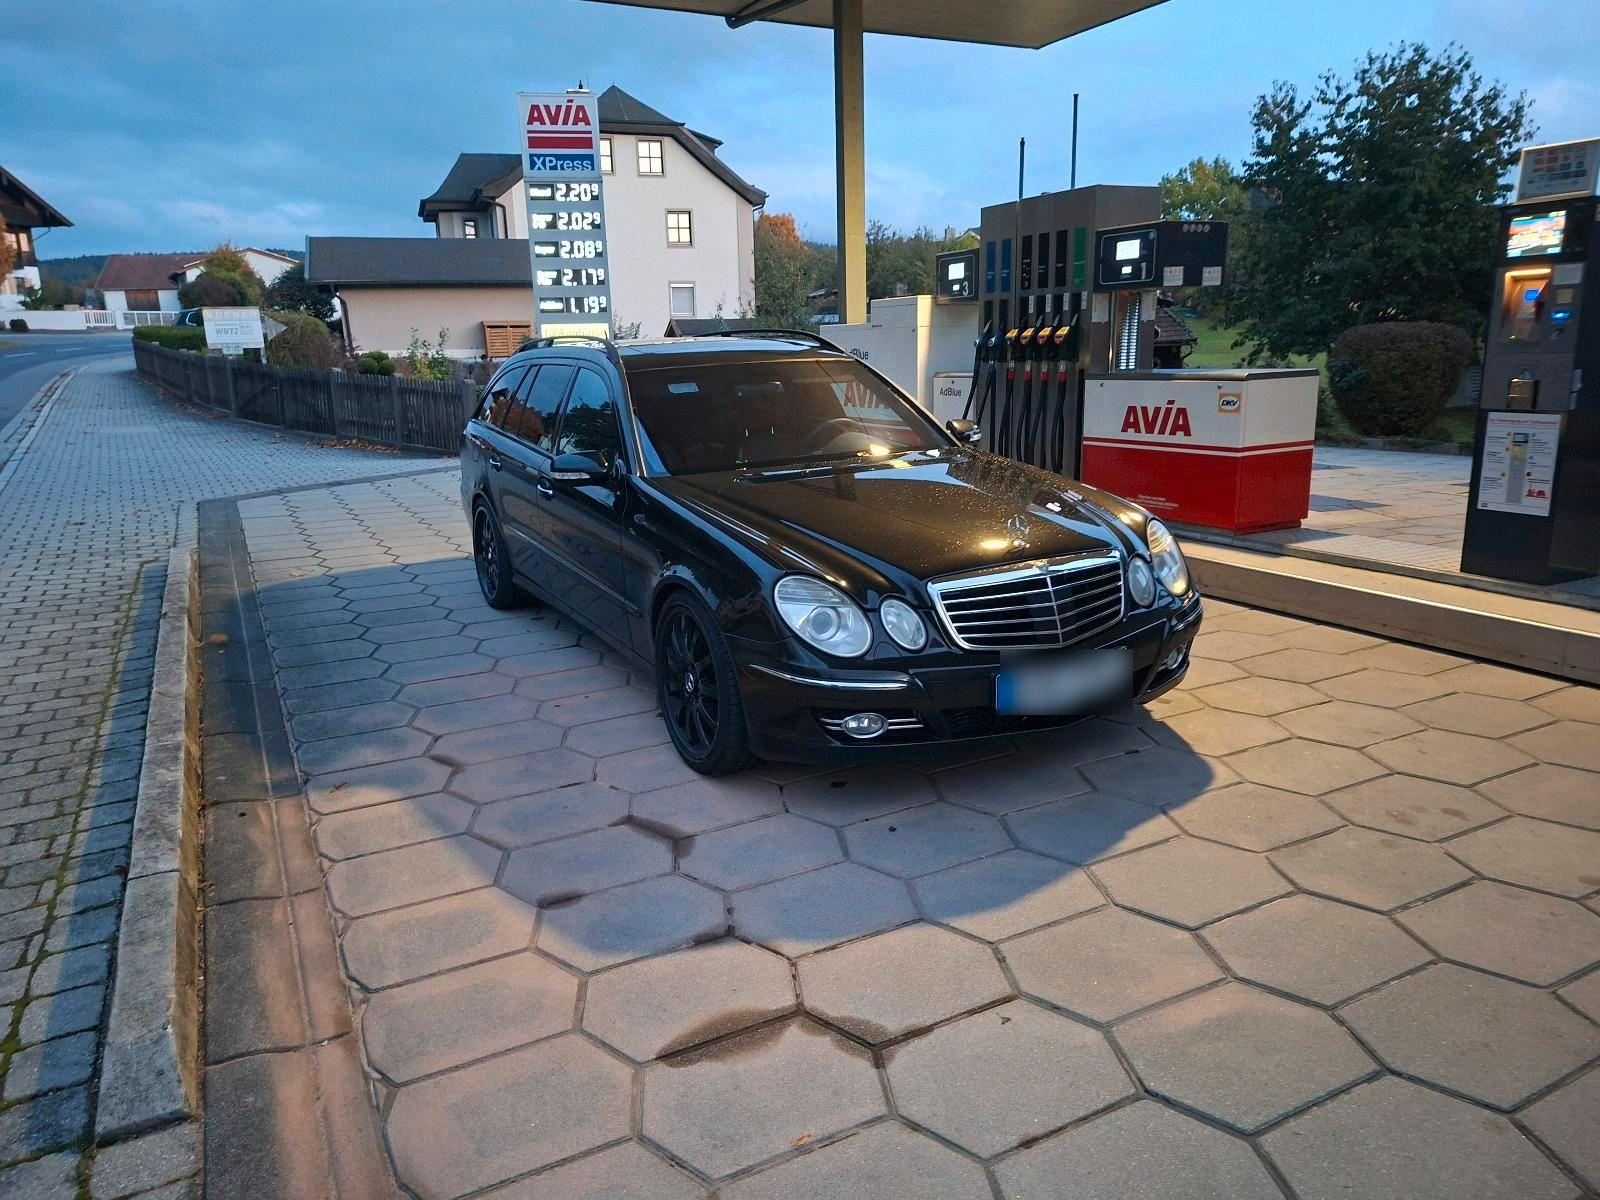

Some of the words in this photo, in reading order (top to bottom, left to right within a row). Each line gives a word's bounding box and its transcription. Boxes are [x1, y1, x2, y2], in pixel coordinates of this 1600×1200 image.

[533, 156, 593, 171] XPress
[1141, 262, 1147, 280] 1
[962, 281, 969, 296] 3
[939, 387, 962, 396] AdBlue
[1221, 399, 1239, 407] DKV
